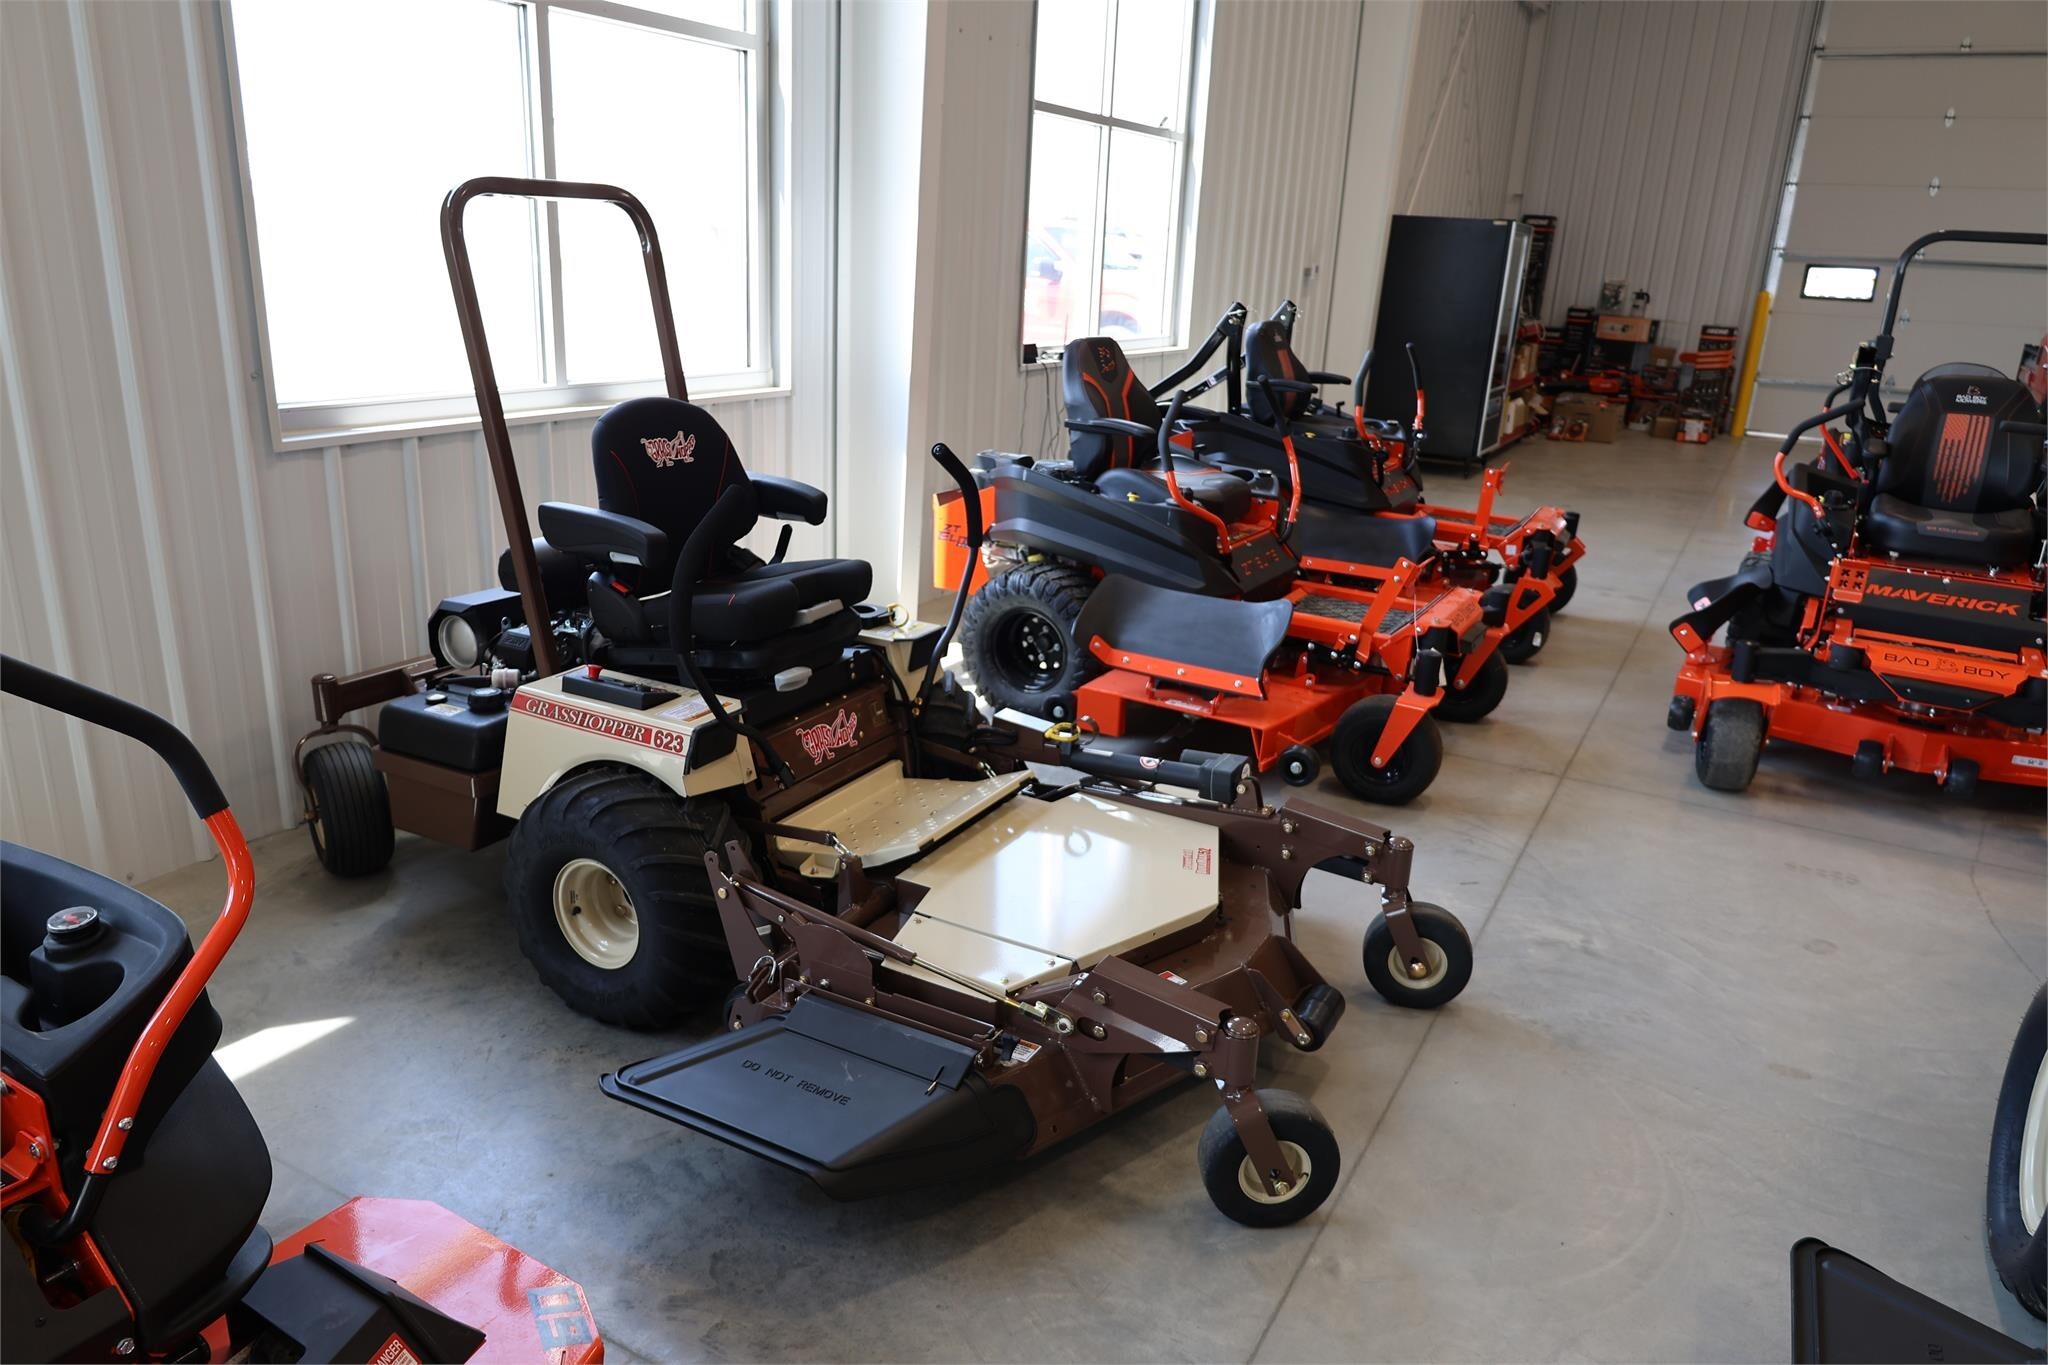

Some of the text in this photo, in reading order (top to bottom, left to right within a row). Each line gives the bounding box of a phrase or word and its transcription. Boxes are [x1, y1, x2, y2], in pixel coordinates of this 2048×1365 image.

[1865, 583, 2022, 616] MAVERICK
[1884, 653, 2011, 680] BAD BOY
[525, 698, 645, 742] GRASSHOPPER
[653, 730, 684, 753] 623
[742, 1060, 851, 1106] DO NOT REMOVE
[374, 1339, 403, 1364] ANGER
